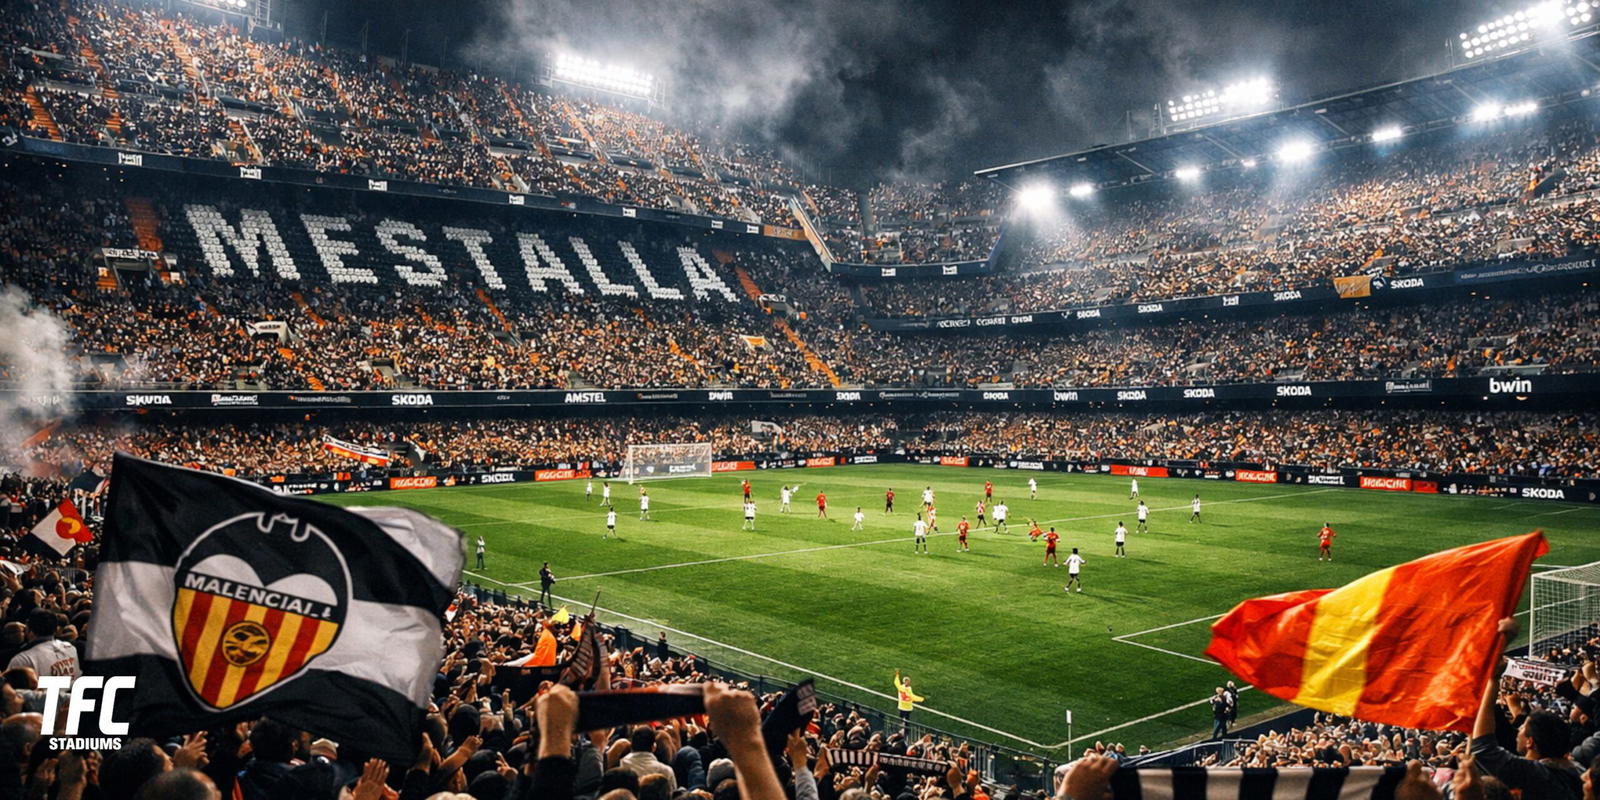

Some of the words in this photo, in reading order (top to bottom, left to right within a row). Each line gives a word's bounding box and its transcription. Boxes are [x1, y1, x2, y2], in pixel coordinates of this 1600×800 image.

[184, 204, 739, 301] MESTALLA
[1489, 377, 1532, 393] bwin
[1183, 388, 1215, 399] SKODA
[1276, 386, 1312, 396] SKODA
[392, 394, 433, 405] SKODA
[565, 392, 606, 403] AMSTEL
[1522, 488, 1565, 499] SKODA
